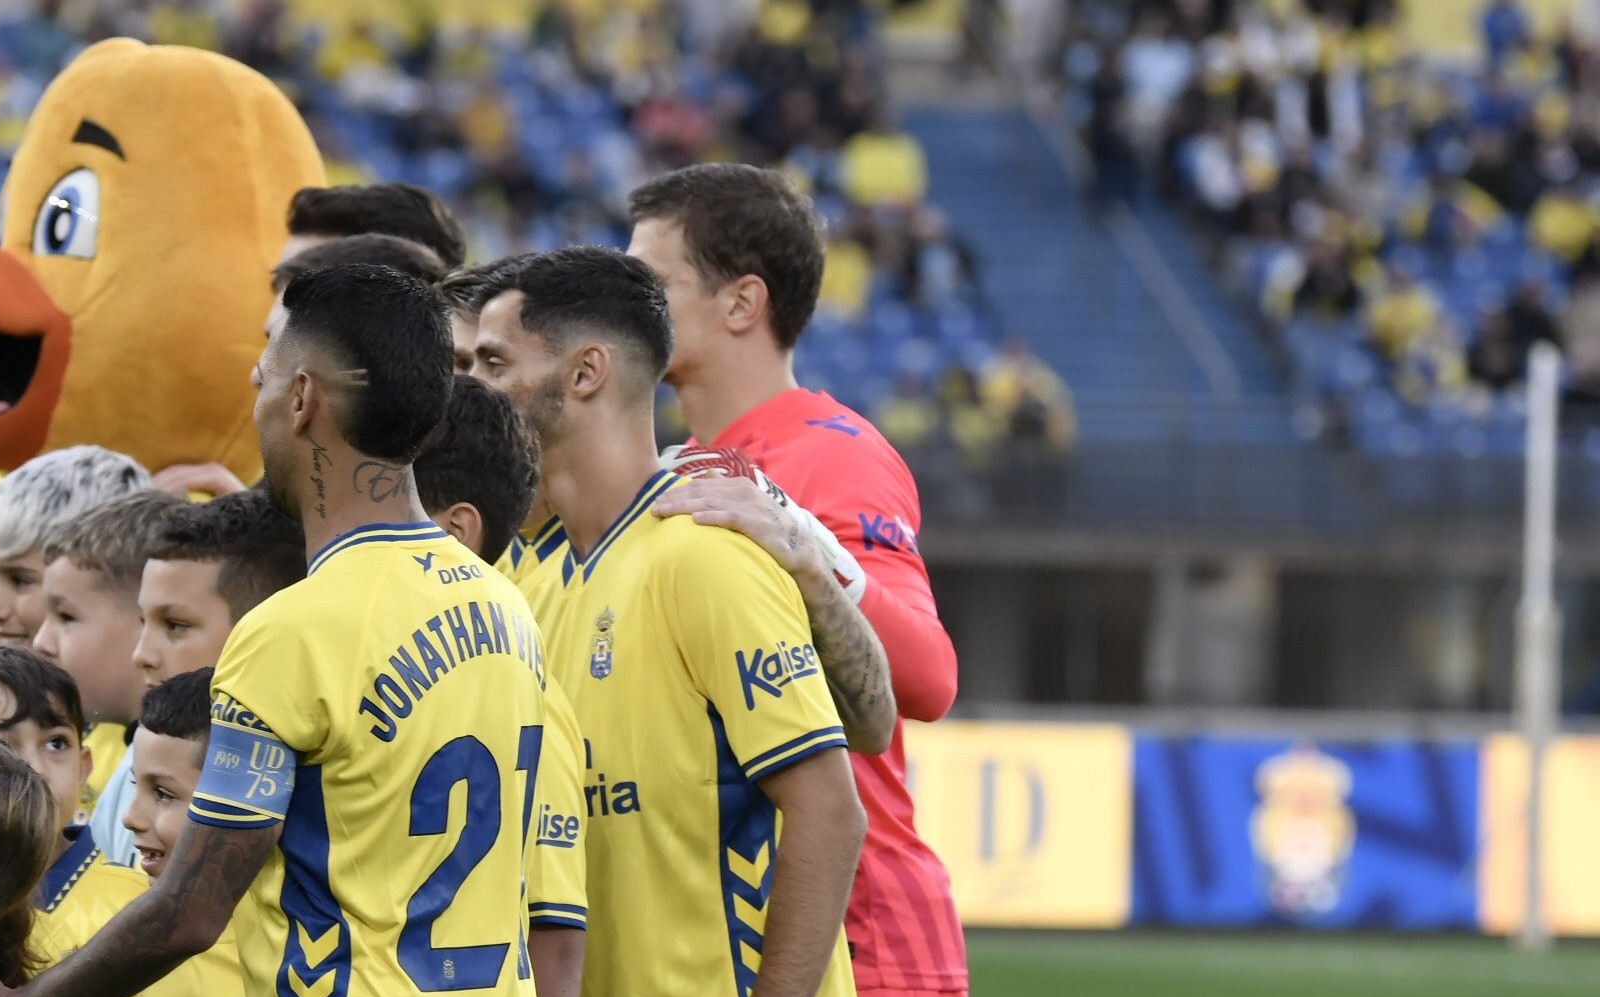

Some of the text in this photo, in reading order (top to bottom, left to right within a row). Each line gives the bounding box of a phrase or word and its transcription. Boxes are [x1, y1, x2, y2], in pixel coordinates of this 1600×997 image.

[359, 601, 511, 742] JONATHAN
[735, 641, 818, 711] Kalise
[214, 741, 285, 770] 1949 UD
[245, 769, 277, 799] 75
